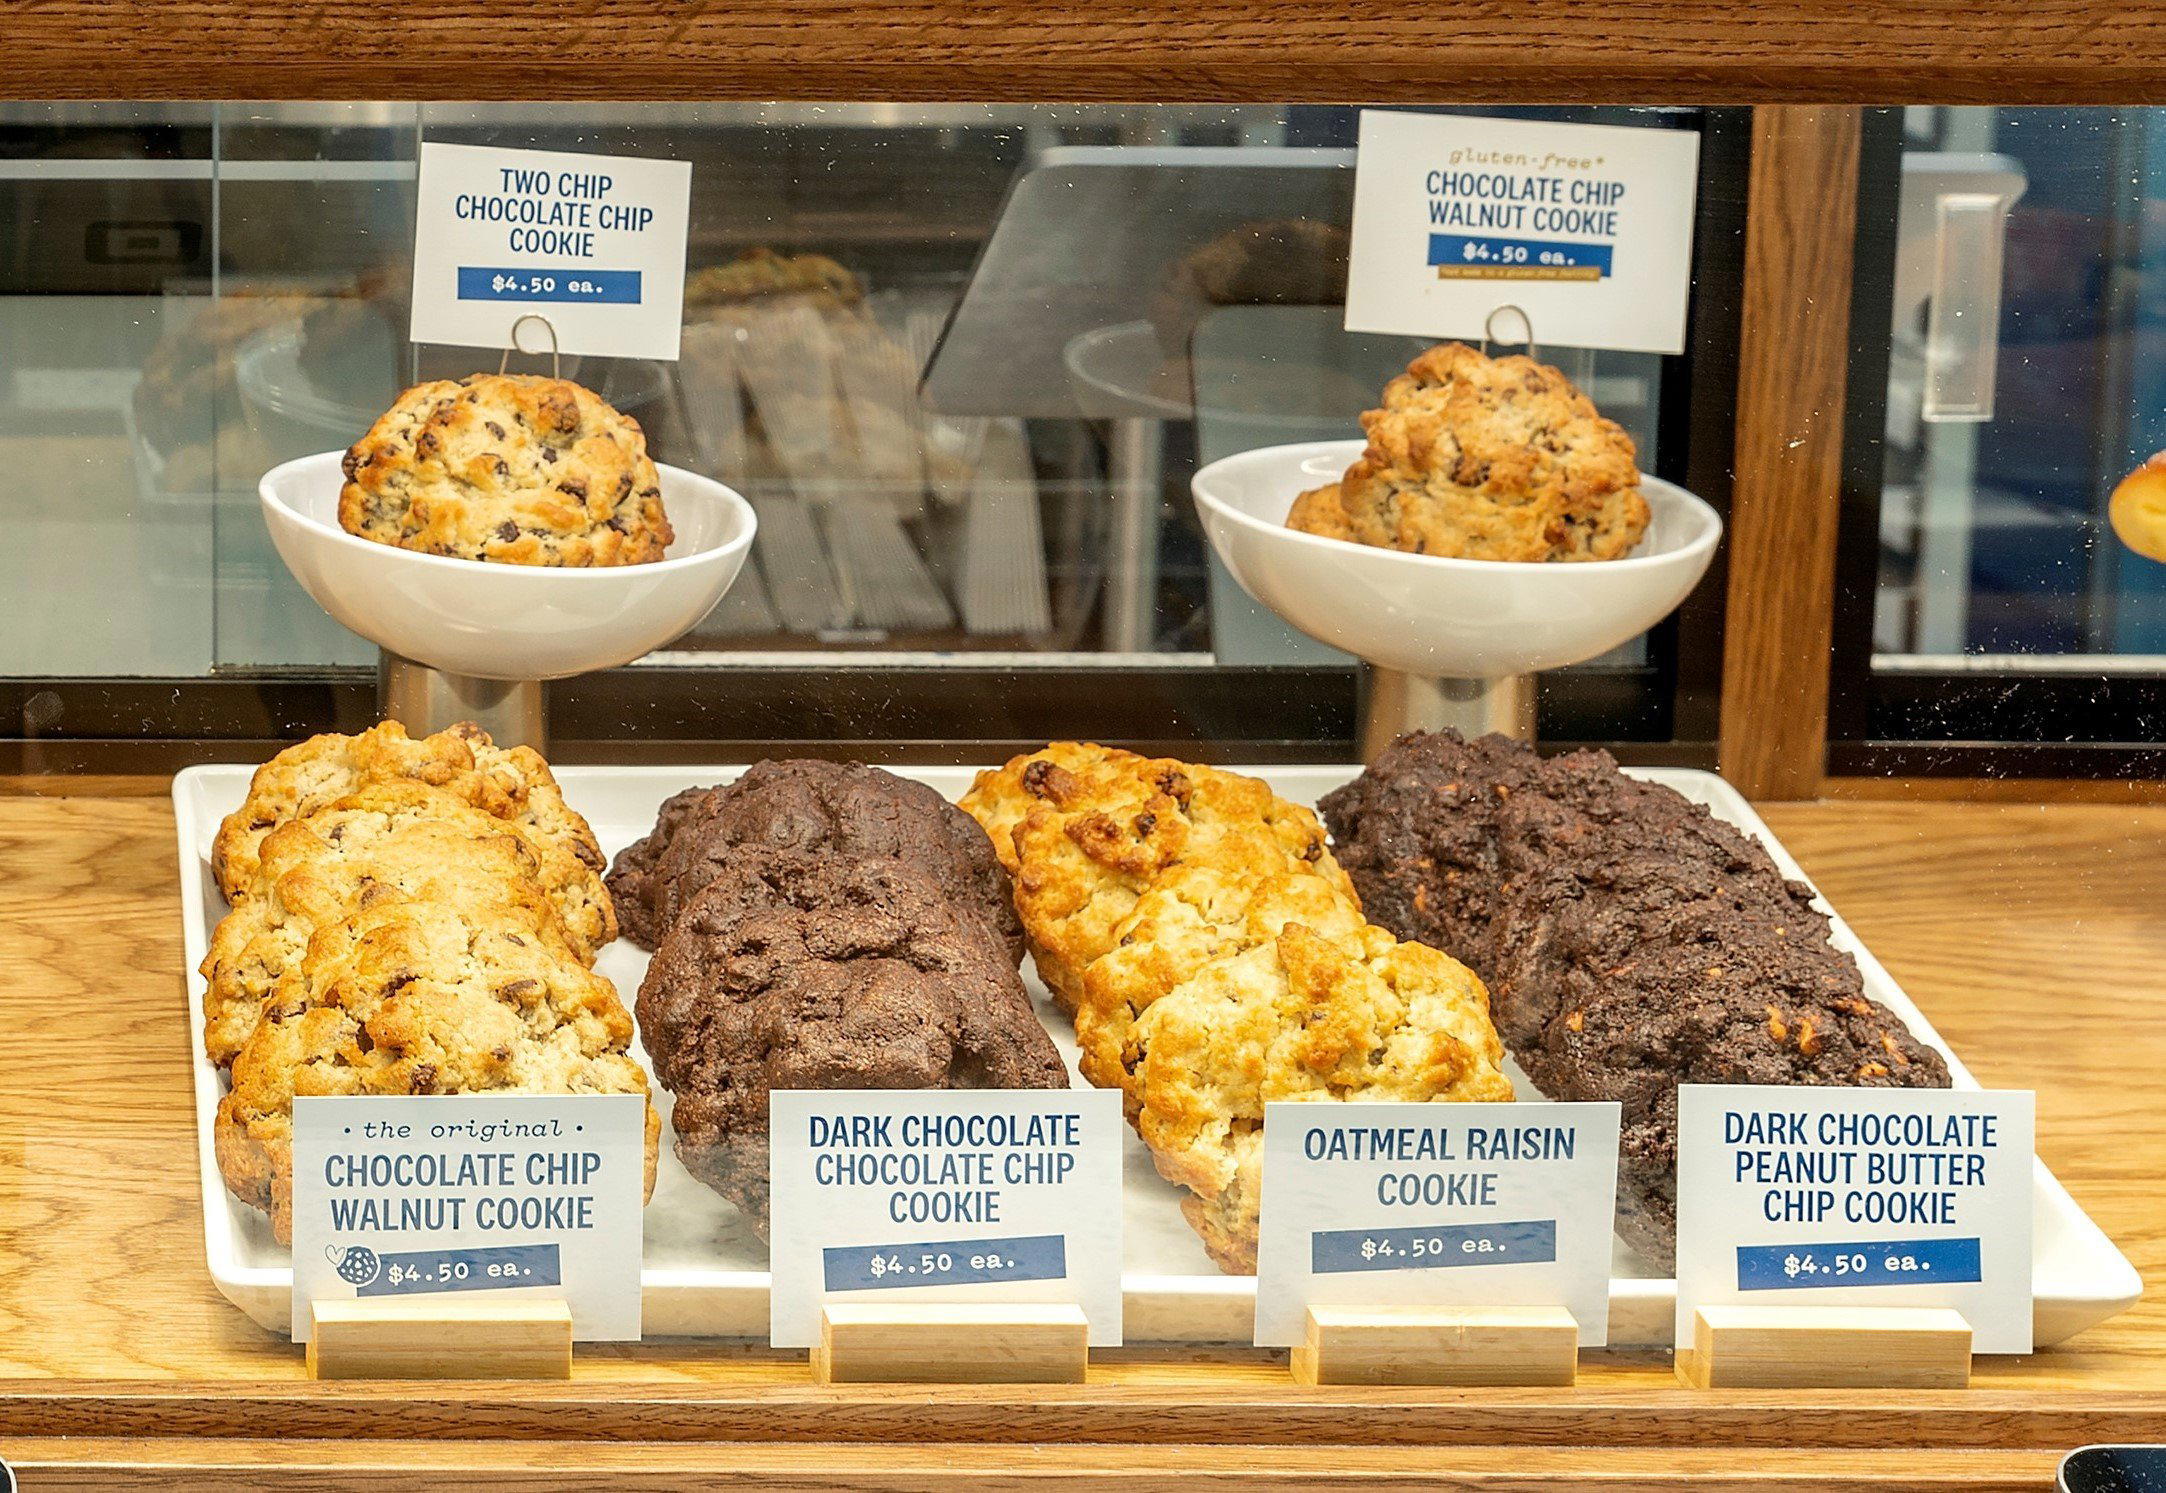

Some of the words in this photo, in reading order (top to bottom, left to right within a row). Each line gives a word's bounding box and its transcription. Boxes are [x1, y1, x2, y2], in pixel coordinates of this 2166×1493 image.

[500, 168, 551, 195] TWO
[558, 173, 613, 199] CHIP
[1426, 171, 1562, 203] CHOCOLATE
[1571, 180, 1625, 206] CHIP
[456, 194, 591, 228] CHOCOLATE
[599, 205, 653, 231] CHIP
[1429, 200, 1526, 230] WALNUT
[1533, 208, 1618, 236] COOKIE
[510, 228, 595, 257] COOKIE
[1463, 241, 1528, 262] $4.50
[1539, 251, 1575, 266] ea.
[492, 274, 555, 293] $4.50
[568, 281, 603, 293] ea.
[364, 1121, 411, 1139] the
[430, 1119, 562, 1143] original
[809, 1115, 892, 1147] DARK
[902, 1114, 1080, 1147] CHOCOLATE
[1305, 1127, 1456, 1161] OATMEAL
[1467, 1127, 1576, 1160] RAISIN
[1725, 1111, 1808, 1144] DARK
[1818, 1113, 1998, 1147] CHOCOLATE
[325, 1153, 515, 1187] CHOCOLATE
[526, 1152, 601, 1185] CHIP
[815, 1153, 994, 1185] CHOCOLATE
[1004, 1152, 1074, 1184] CHIP
[1736, 1151, 1858, 1184] PEANUT
[1867, 1152, 1985, 1186] BUTTER
[1377, 1173, 1498, 1206] COOKIE
[331, 1197, 466, 1231] WALNUT
[476, 1196, 594, 1230] COOKIE
[889, 1191, 1000, 1223] COOKIE
[1764, 1190, 1835, 1223] CHIP
[1845, 1190, 1957, 1224] COOKIE
[1361, 1237, 1444, 1260] $4.50
[1461, 1236, 1506, 1253] ea.
[387, 1262, 469, 1285] $4.50
[486, 1260, 532, 1277] ea.
[870, 1253, 952, 1278] $4.50
[970, 1252, 1015, 1269] ea.
[1784, 1253, 1867, 1277] $4.50
[1884, 1253, 1930, 1271] ea.
